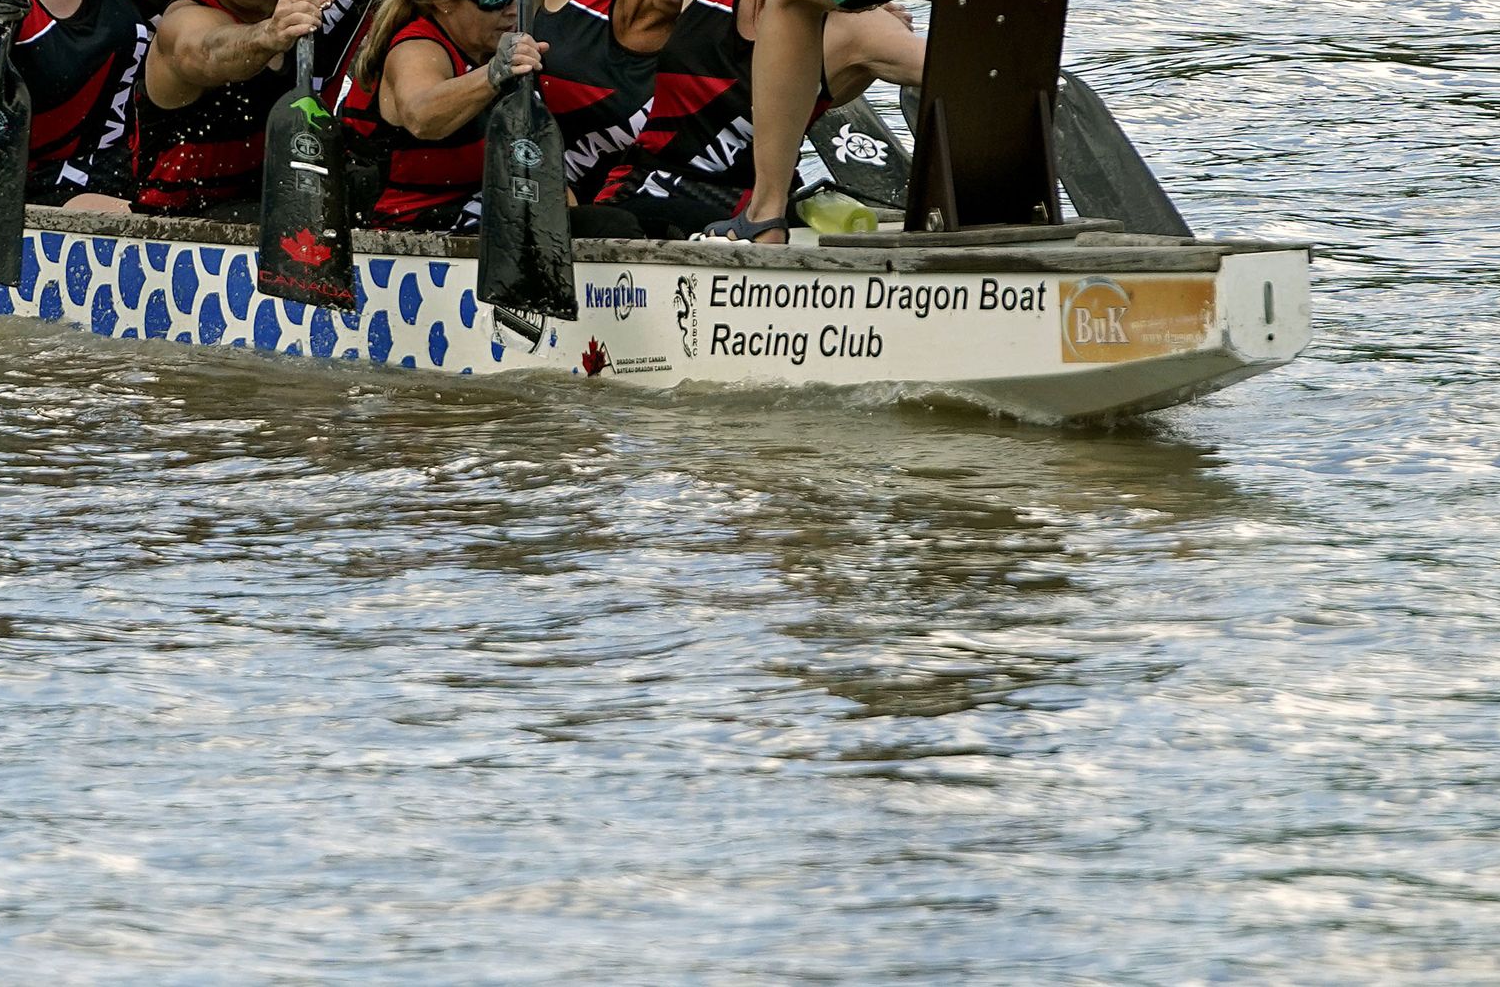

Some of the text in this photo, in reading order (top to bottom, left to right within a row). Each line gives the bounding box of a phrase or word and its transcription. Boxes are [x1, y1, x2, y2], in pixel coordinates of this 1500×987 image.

[259, 269, 353, 299] CANADA
[710, 275, 1047, 318] Edmonton Dragon Boat
[710, 323, 884, 365] Racing Club
[1074, 306, 1130, 344] BuK
